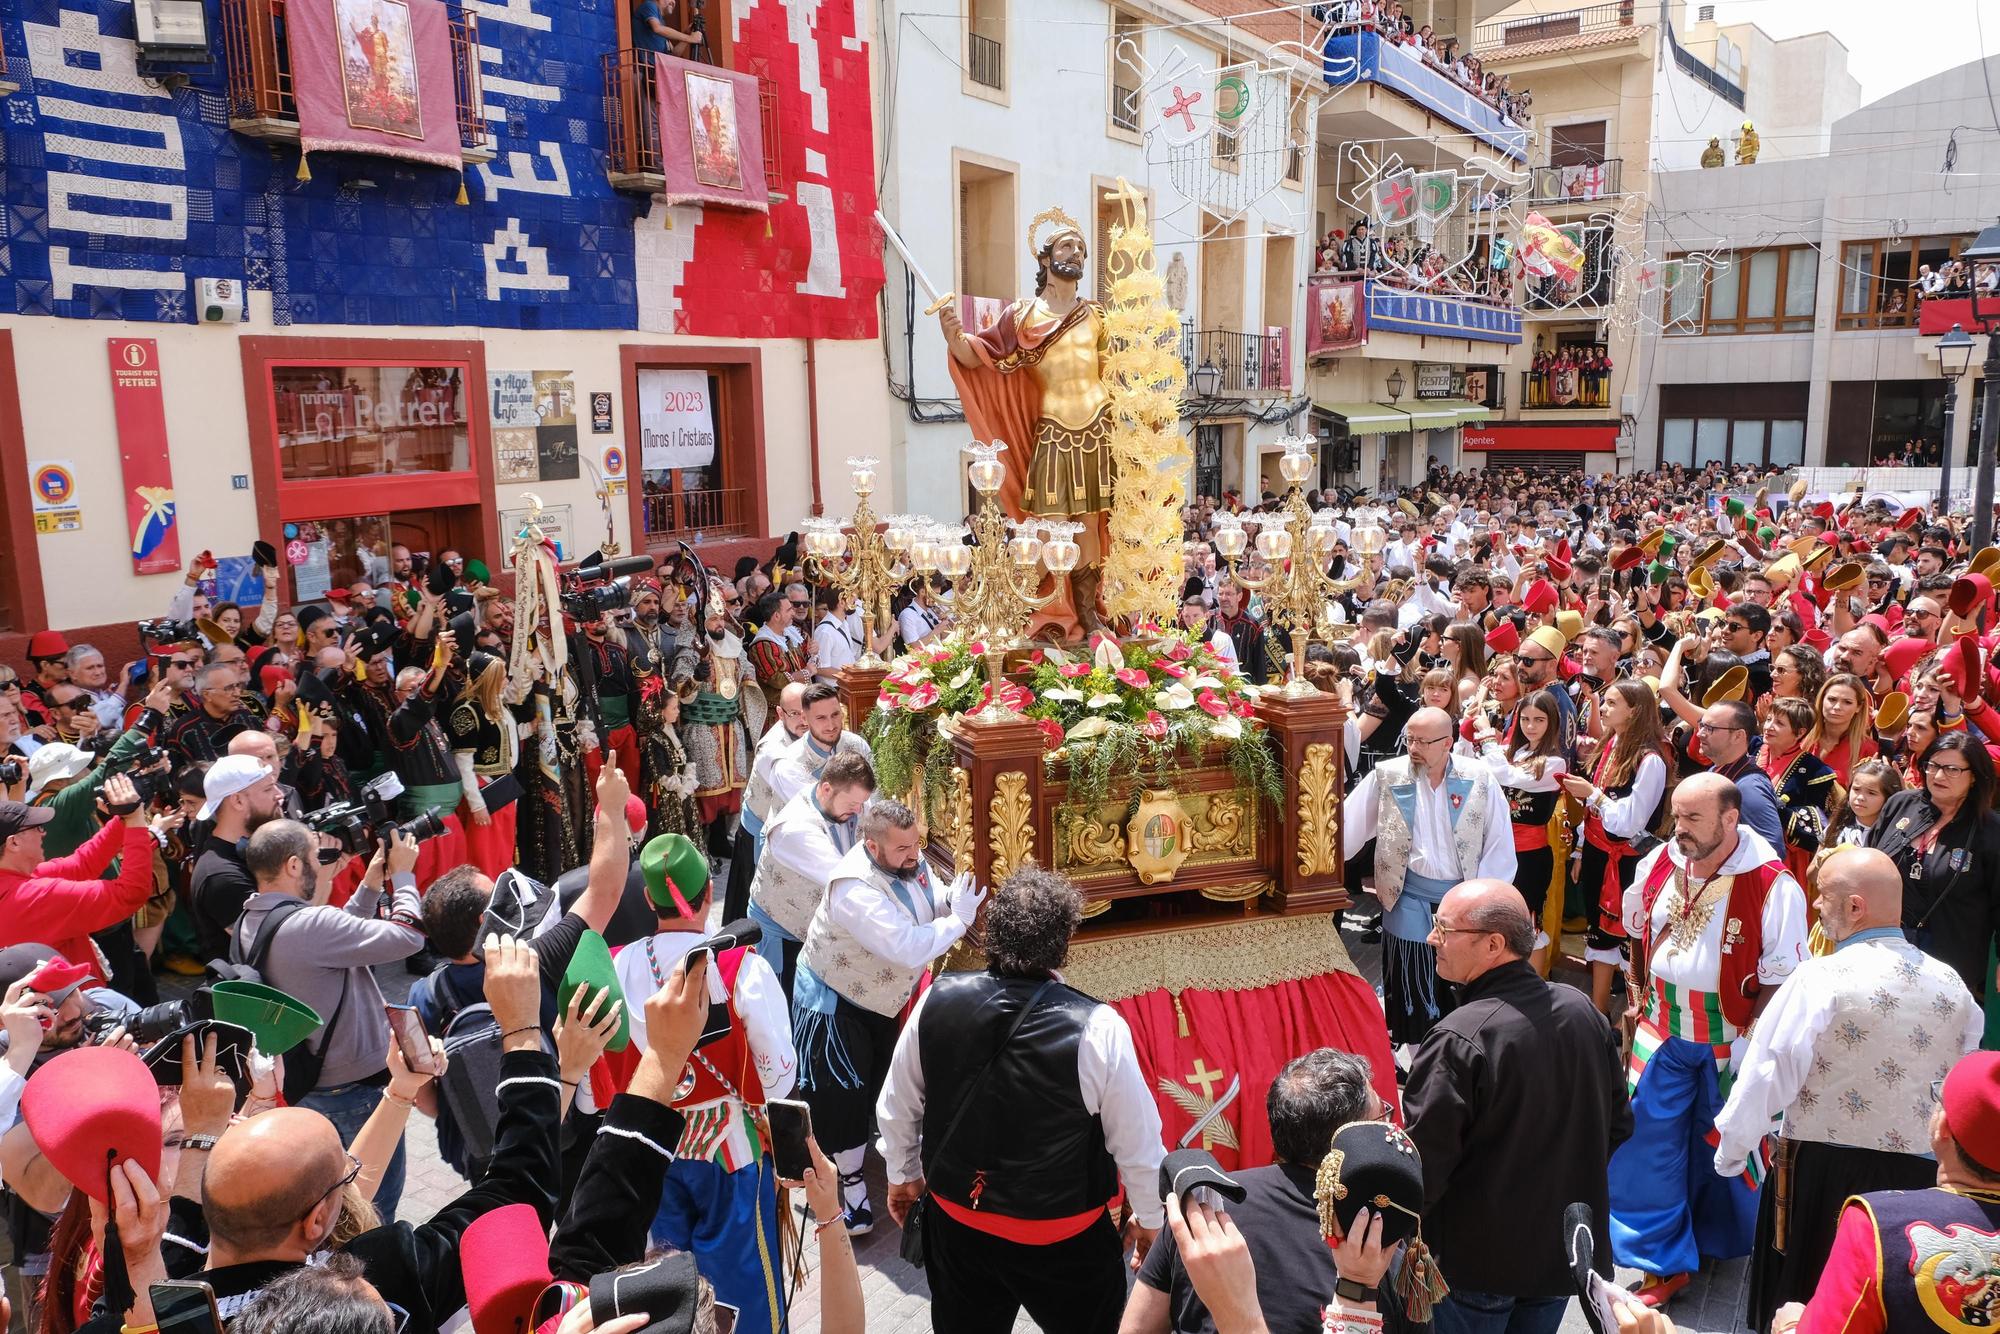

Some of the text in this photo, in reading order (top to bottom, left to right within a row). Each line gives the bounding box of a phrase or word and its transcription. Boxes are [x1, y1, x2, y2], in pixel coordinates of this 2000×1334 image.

[118, 378, 157, 387] PETRER
[503, 374, 528, 394] Algo
[1420, 376, 1449, 386] FESTER
[501, 391, 533, 406] más que
[664, 391, 704, 413] 2023
[354, 394, 450, 427] Petrer
[643, 428, 669, 448] Moros
[678, 427, 713, 447] Cristians
[1464, 436, 1495, 446] Agentes
[497, 449, 535, 460] CROCHET
[235, 477, 247, 488] 10
